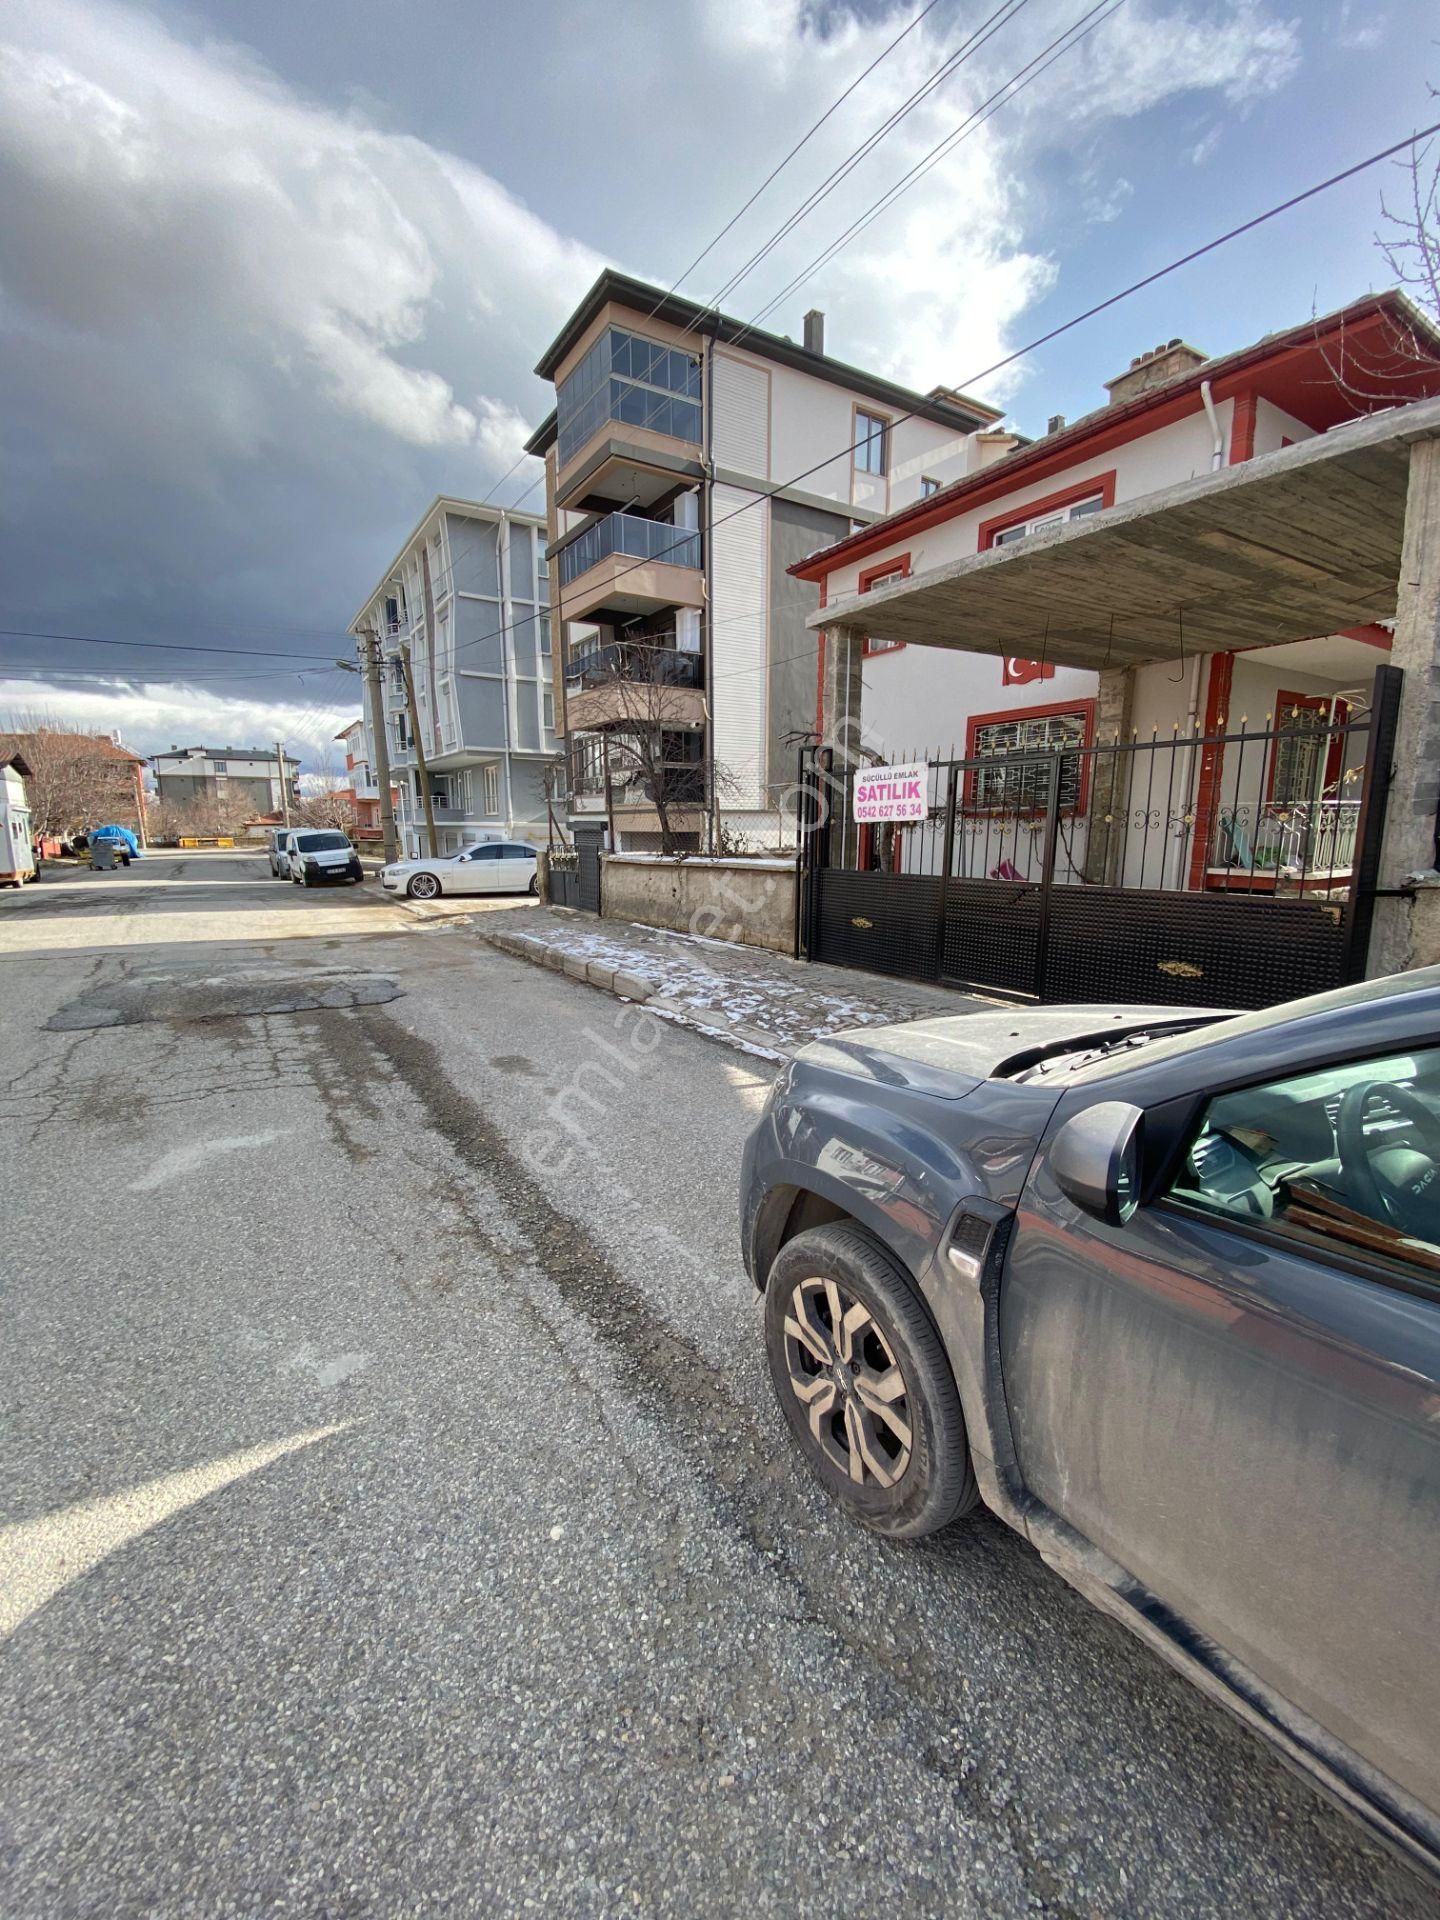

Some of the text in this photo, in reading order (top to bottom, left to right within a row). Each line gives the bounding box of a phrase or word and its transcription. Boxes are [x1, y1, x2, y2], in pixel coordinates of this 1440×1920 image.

[862, 771, 919, 783] SÜCÜLLÜ EMLAK
[857, 781, 920, 802] SATILIK
[857, 803, 922, 818] 0542 627 56 34
